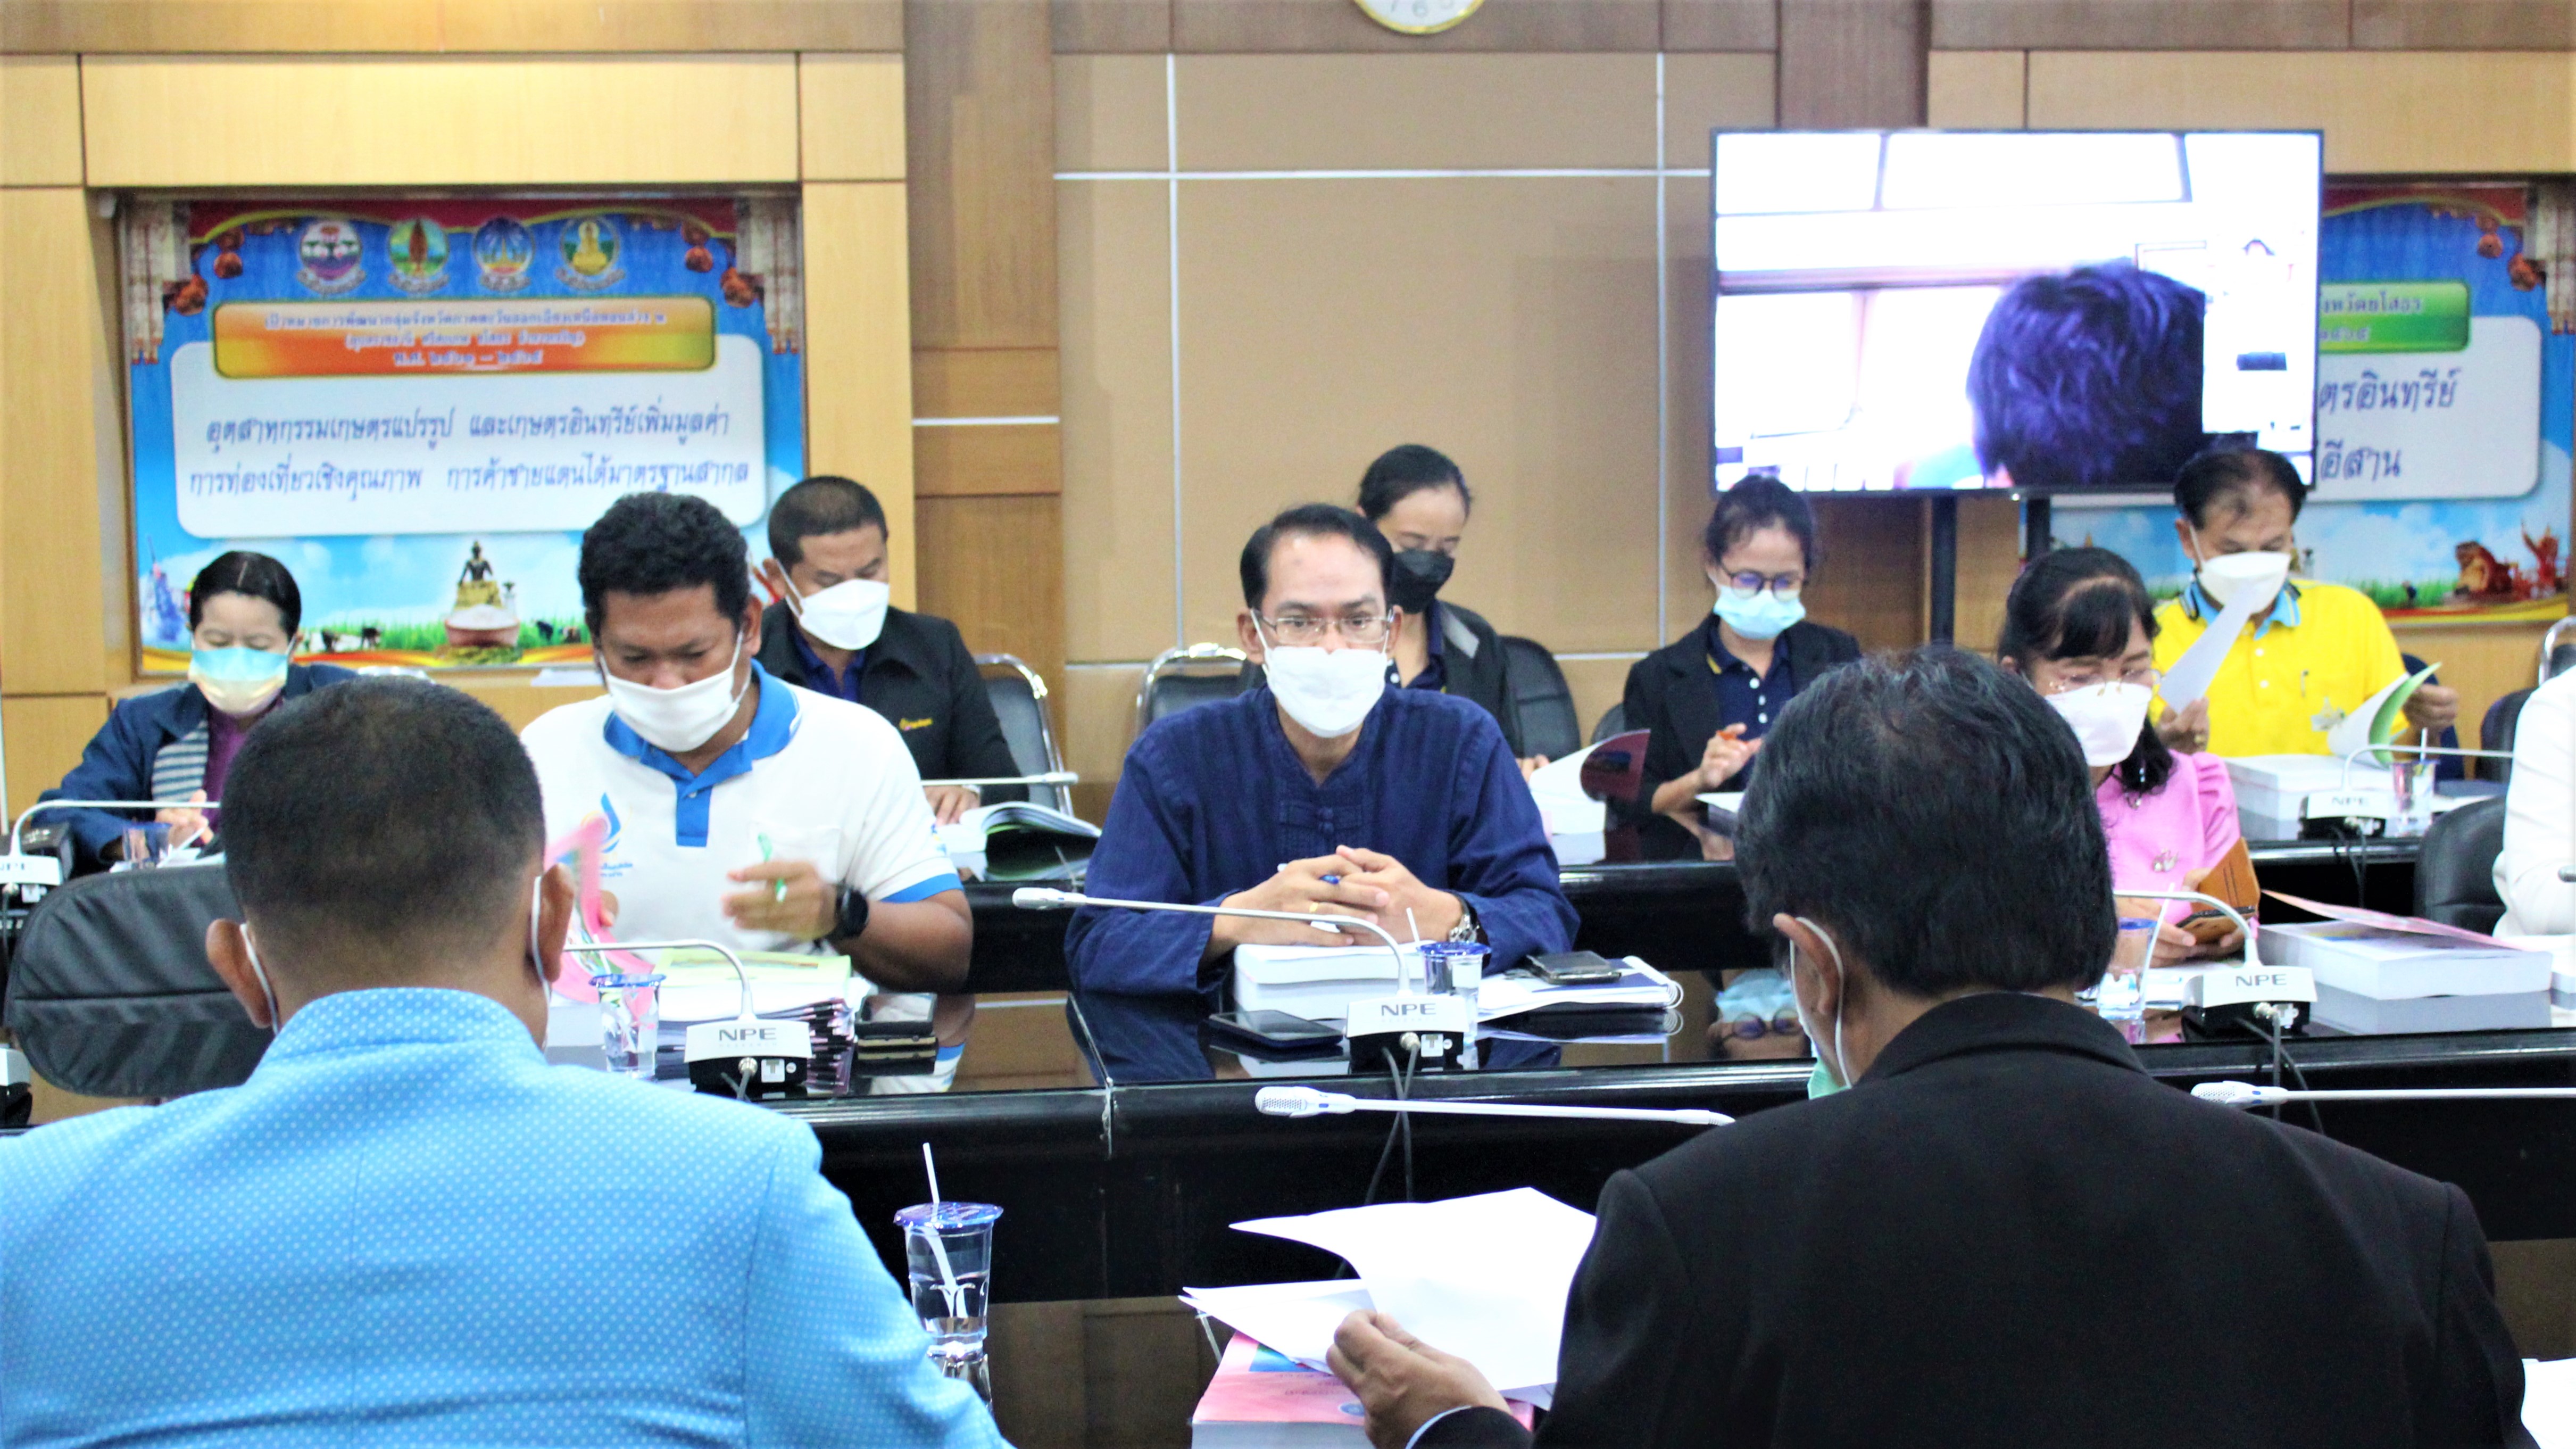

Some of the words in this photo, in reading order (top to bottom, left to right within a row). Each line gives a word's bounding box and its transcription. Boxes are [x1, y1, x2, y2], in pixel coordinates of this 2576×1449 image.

[2319, 290, 2423, 313] งหวัดยโสธร
[2319, 367, 2462, 415] ตรอินทรีย์
[206, 406, 456, 453] อุตสาหกรรมเกษตรแปรรูป
[470, 394, 730, 445] และเกษตรอินทรีย์เพิ่มมูลค่า
[189, 452, 423, 501] การท่องเที่ยวเชิงคุณภาพ
[447, 452, 749, 492] การค้าชายแดนได้มาตรฐานสากล
[2236, 973, 2287, 987] NPE
[1382, 1003, 1436, 1016] NPE
[719, 1028, 776, 1041] NPE
